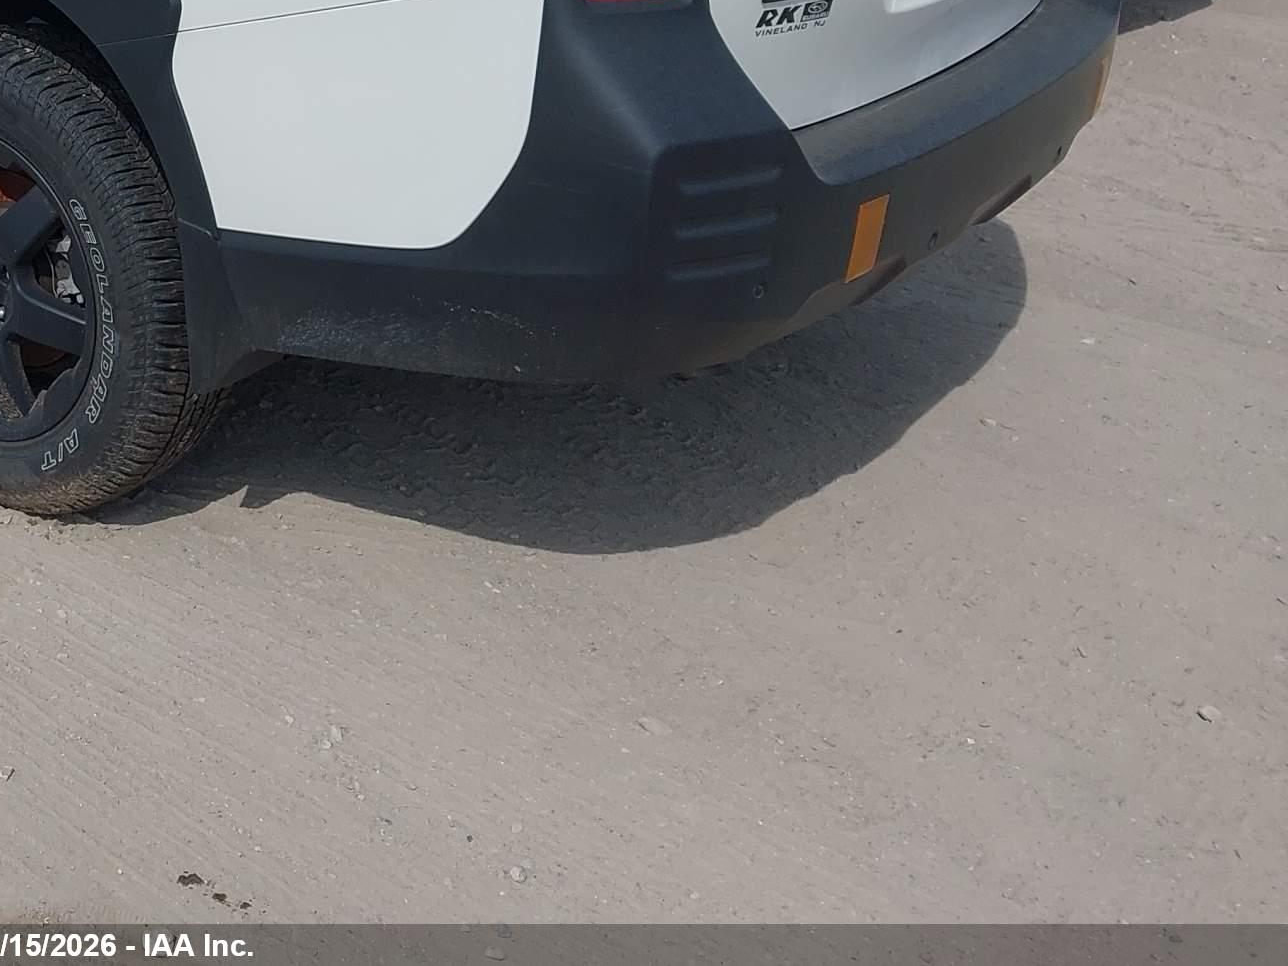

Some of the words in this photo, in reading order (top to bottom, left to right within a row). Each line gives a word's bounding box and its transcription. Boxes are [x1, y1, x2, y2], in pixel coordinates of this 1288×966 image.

[755, 5, 802, 28] RK
[755, 23, 808, 37] VINELAND
[69, 199, 114, 423] GEOLANDAR
[41, 428, 79, 471] A/T
